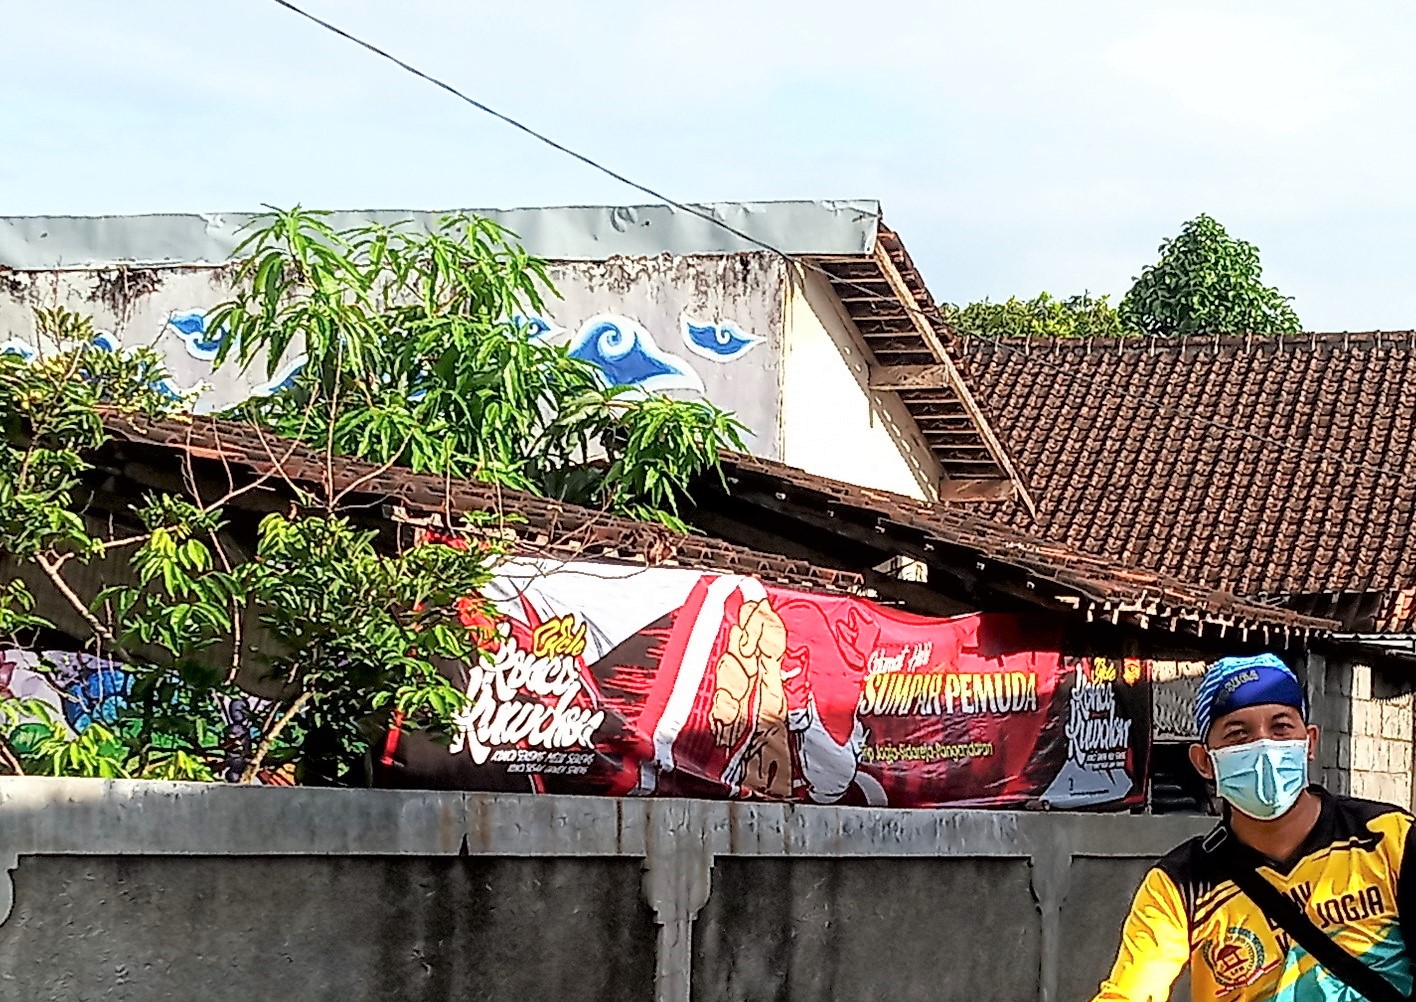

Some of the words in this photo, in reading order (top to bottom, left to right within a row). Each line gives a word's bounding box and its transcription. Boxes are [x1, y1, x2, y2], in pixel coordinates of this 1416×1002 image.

[860, 672, 945, 715] SUMPAH
[944, 672, 1037, 715] PEMUDA
[1315, 886, 1385, 929] JOGJA
